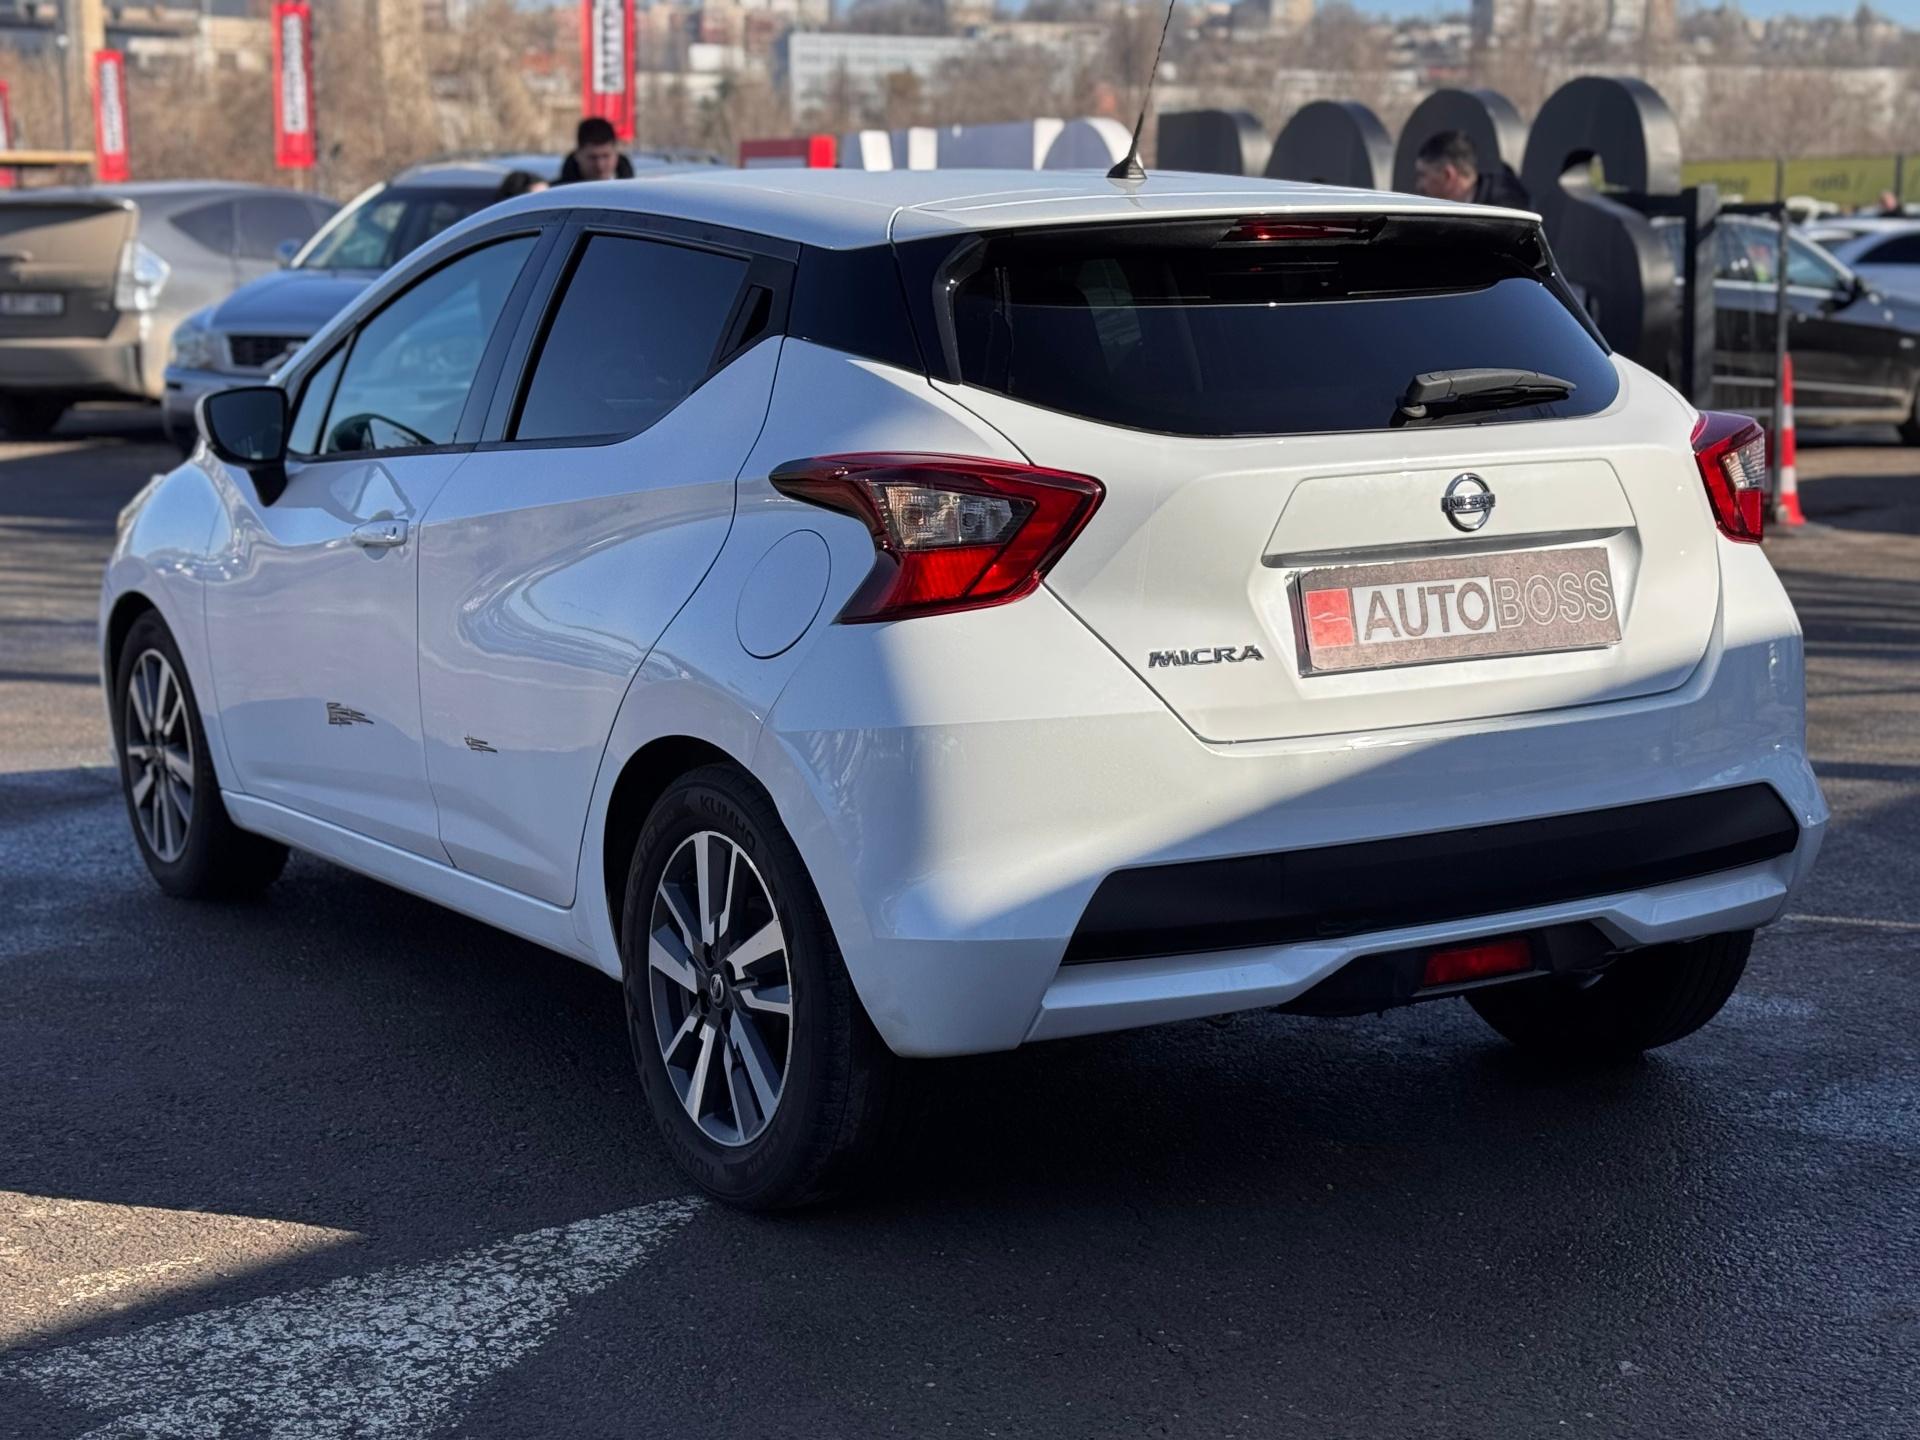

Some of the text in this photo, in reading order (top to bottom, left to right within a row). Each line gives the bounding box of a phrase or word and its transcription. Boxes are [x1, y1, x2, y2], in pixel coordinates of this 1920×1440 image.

[1364, 569, 1614, 641] AUTOBOSS
[1148, 645, 1265, 668] MICRA
[700, 795, 756, 849] KUMHO
